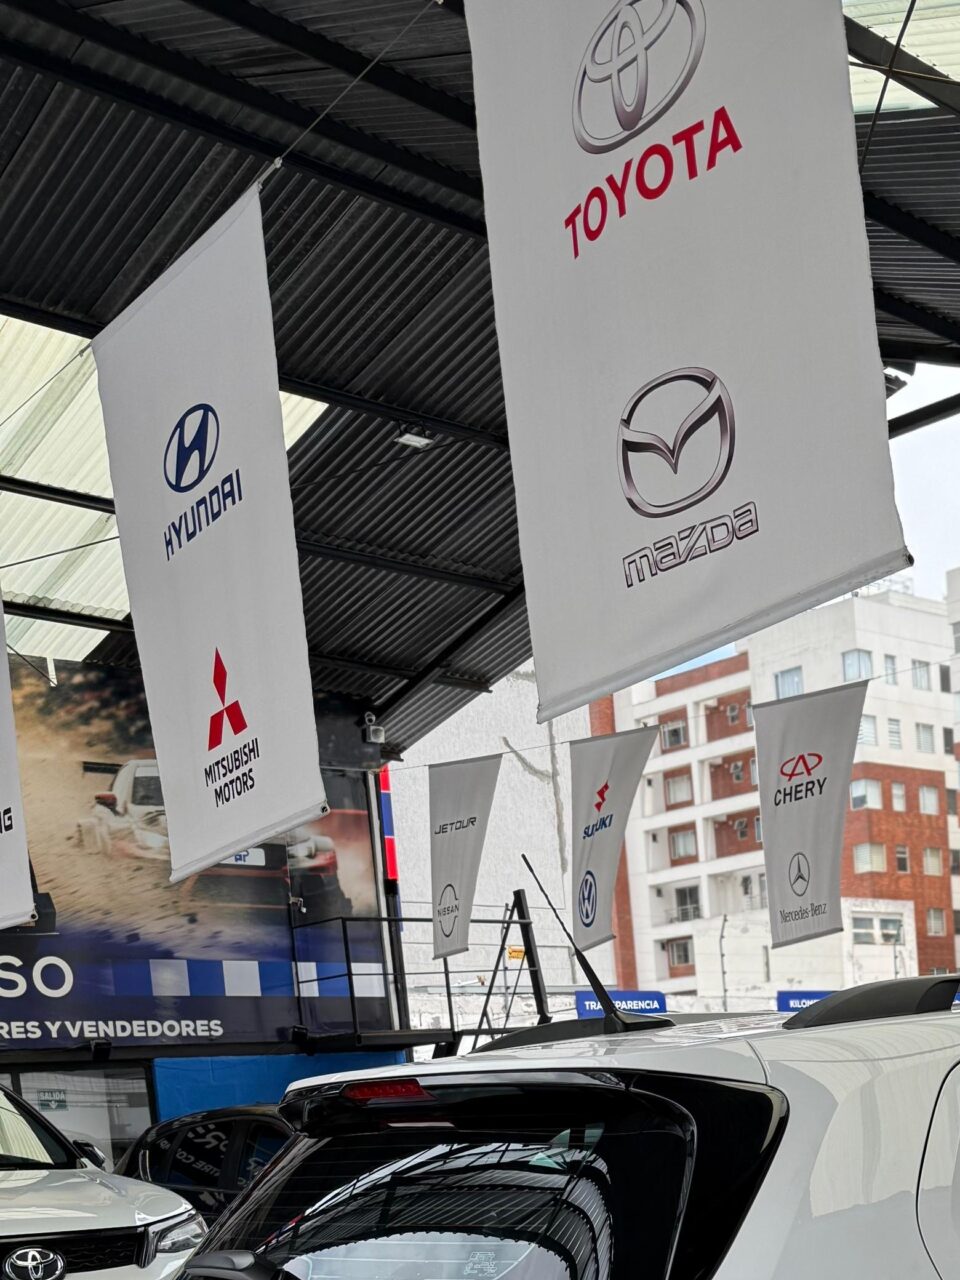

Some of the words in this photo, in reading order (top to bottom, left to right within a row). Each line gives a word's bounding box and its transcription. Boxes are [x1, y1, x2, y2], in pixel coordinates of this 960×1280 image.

[564, 105, 742, 260] TOYOTA
[164, 468, 243, 561] HYUNDAI
[204, 737, 260, 787] MITSUBISHI
[214, 768, 255, 808] MOTORS
[774, 777, 827, 807] CHERY
[434, 816, 477, 834] JETOUR
[437, 904, 459, 918] NISSAN
[779, 902, 828, 924] Mercedes-Benz
[584, 1000, 660, 1010] TRAPARENCIA
[44, 1021, 63, 1038] Y
[64, 1020, 224, 1038] VENDEDORES
[39, 1091, 66, 1101] SALIDA
